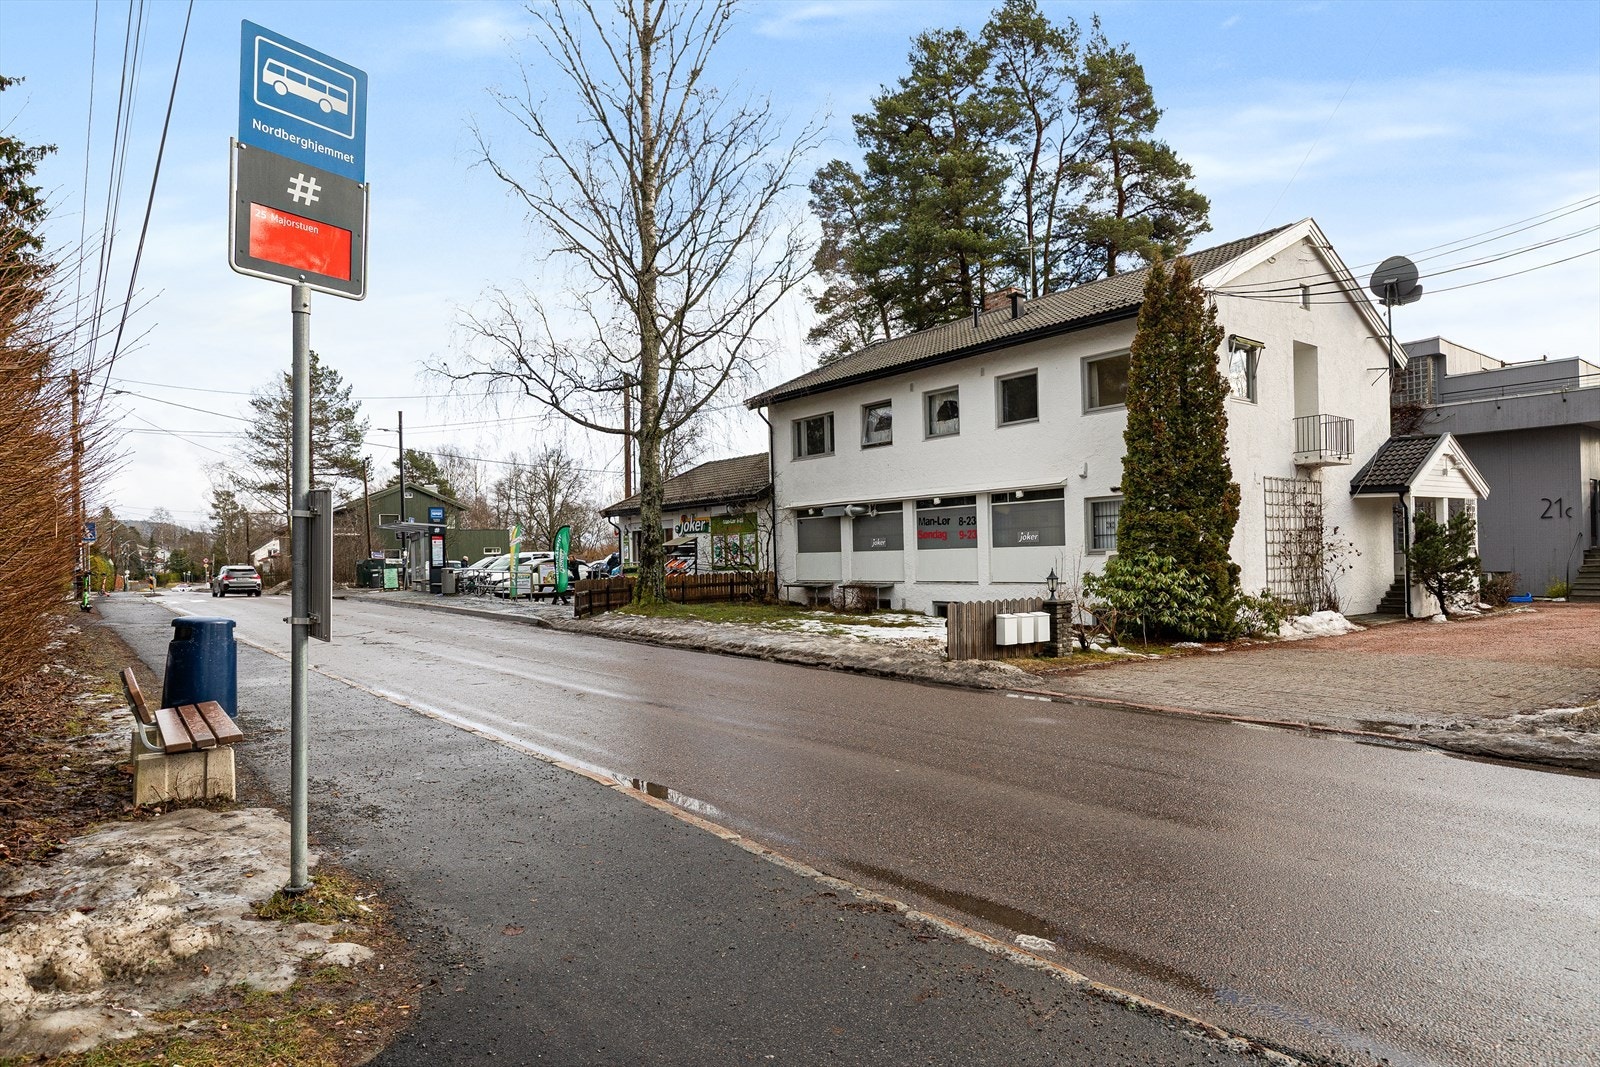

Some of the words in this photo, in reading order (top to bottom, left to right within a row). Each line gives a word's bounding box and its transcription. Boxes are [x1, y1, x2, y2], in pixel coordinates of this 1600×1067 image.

[252, 118, 355, 164] Nordberghjemmet
[254, 208, 267, 220] 25
[270, 213, 319, 235] Majorstuen
[1540, 497, 1573, 519] 21c
[958, 516, 977, 526] 8-23
[958, 529, 977, 540] 9-23
[1018, 531, 1039, 543] joker
